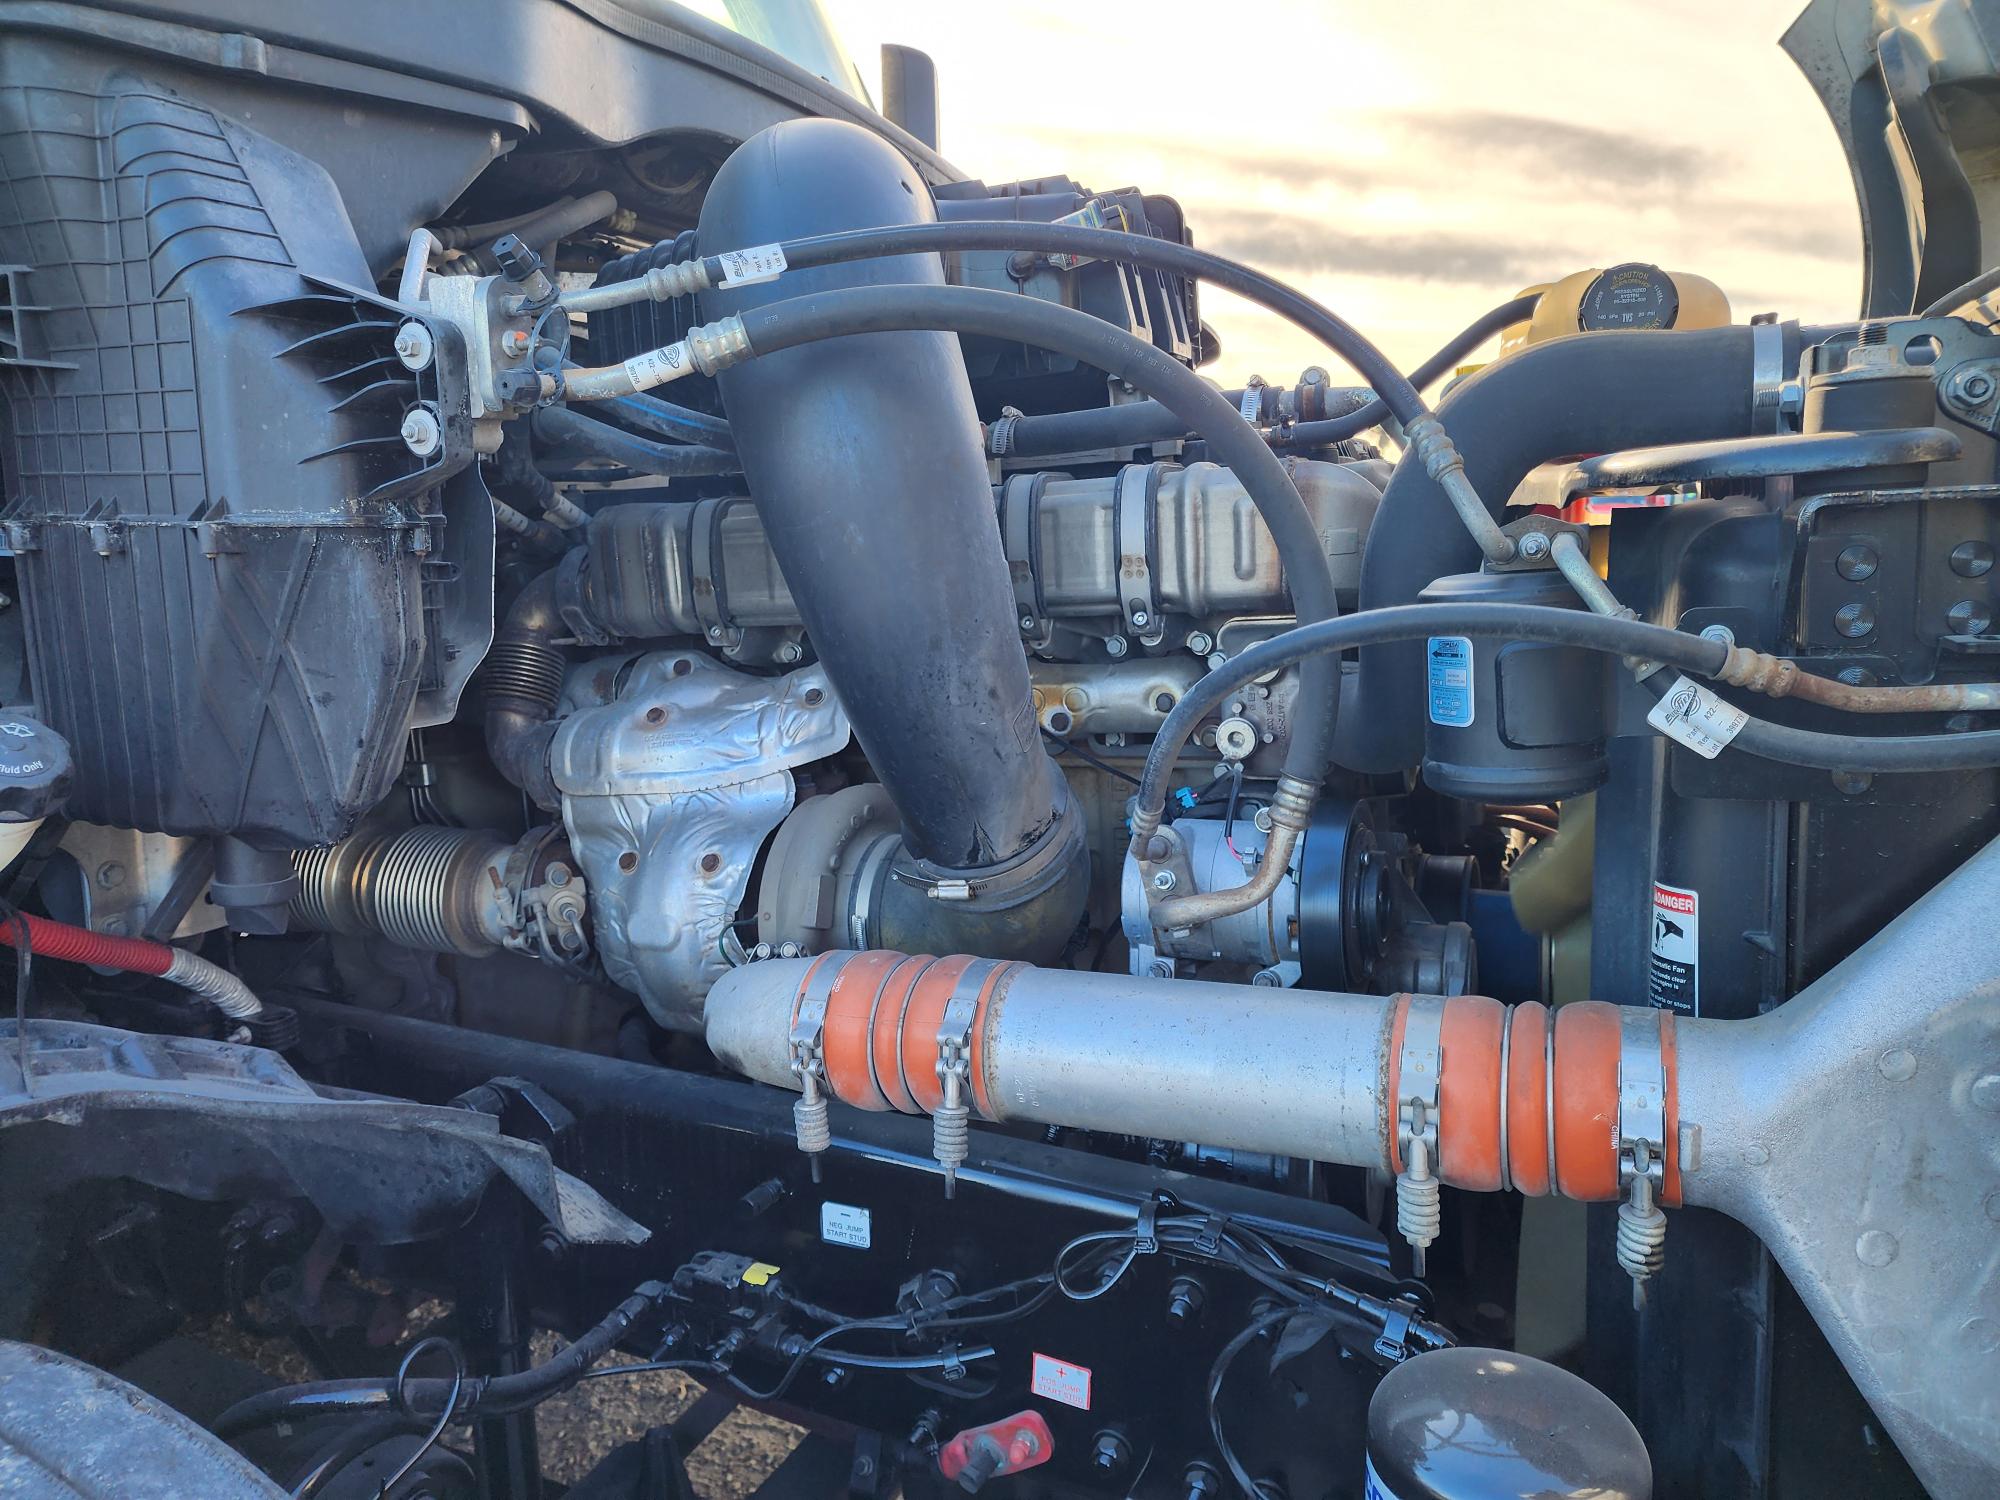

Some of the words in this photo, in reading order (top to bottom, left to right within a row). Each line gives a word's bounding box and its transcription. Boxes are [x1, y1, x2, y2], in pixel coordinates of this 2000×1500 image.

[1617, 271, 1649, 281] CAUTION
[22, 760, 43, 773] Only
[1655, 891, 1694, 912] DANGER
[1672, 964, 1686, 974] Fan
[1671, 976, 1687, 985] clear
[1673, 1001, 1691, 1010] stops
[829, 1220, 843, 1230] NEG
[846, 1225, 864, 1233] JUMP
[826, 1228, 847, 1239] START
[849, 1233, 867, 1243] STUD
